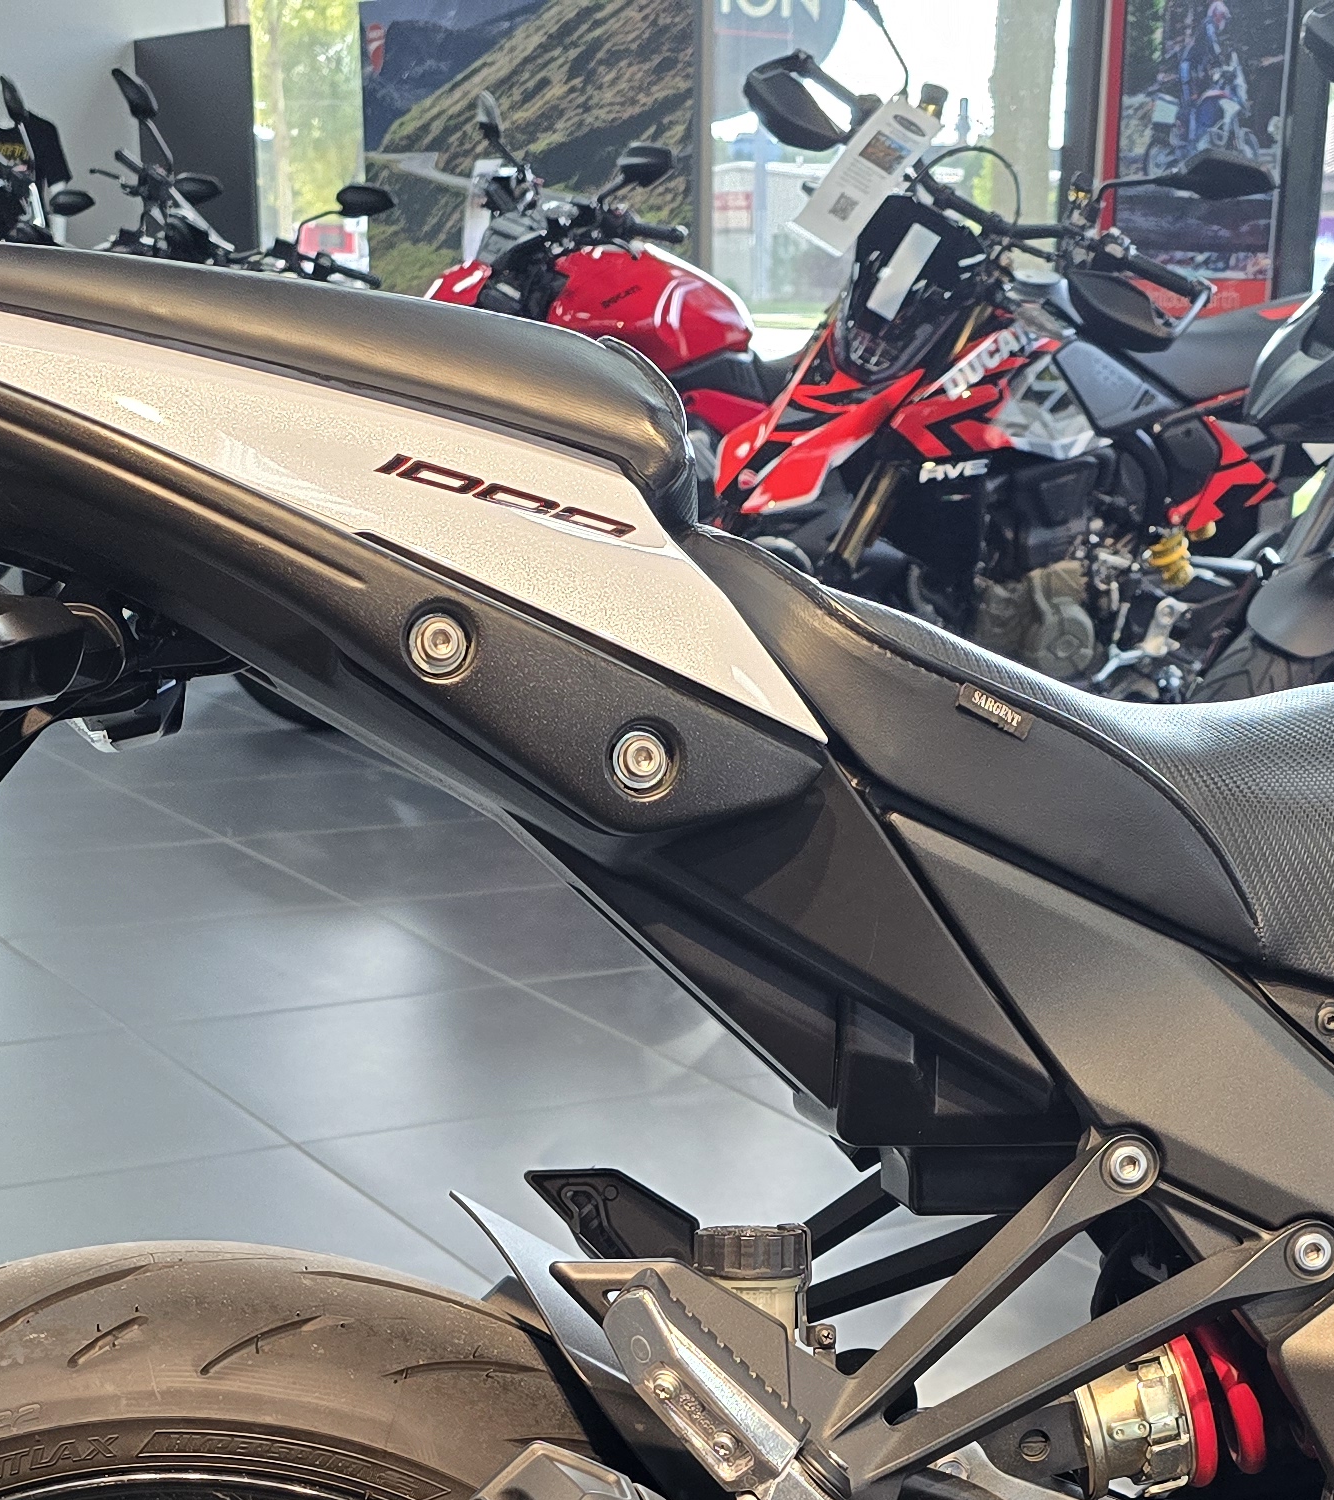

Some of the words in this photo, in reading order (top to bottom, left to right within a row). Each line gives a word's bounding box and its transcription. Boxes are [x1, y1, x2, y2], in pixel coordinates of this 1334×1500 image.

[374, 453, 637, 538] 1000
[971, 690, 1022, 727] SARGENT
[166, 1433, 373, 1479] HYPERSPORT
